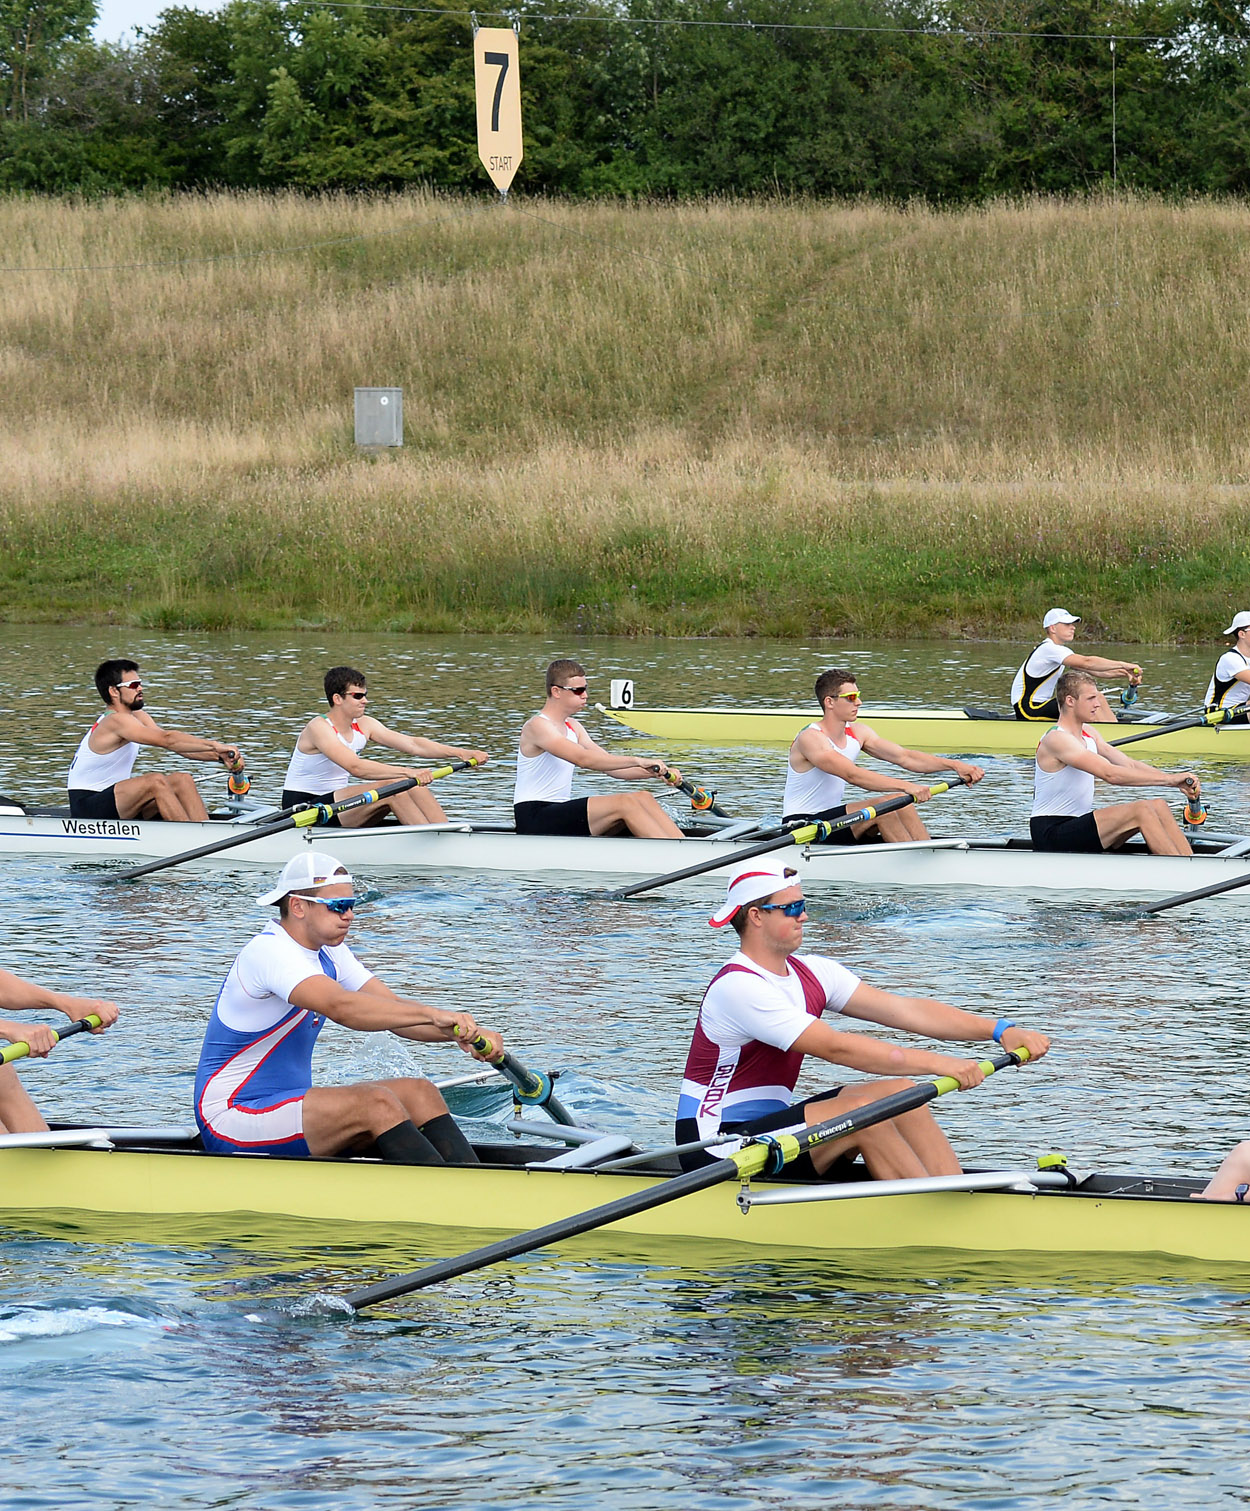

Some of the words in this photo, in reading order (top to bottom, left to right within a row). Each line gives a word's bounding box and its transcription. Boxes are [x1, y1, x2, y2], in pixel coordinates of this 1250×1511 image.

[484, 51, 509, 132] 7
[490, 156, 512, 171] START
[621, 681, 632, 705] 6
[61, 819, 141, 836] Westfalen
[818, 1121, 847, 1139] concept
